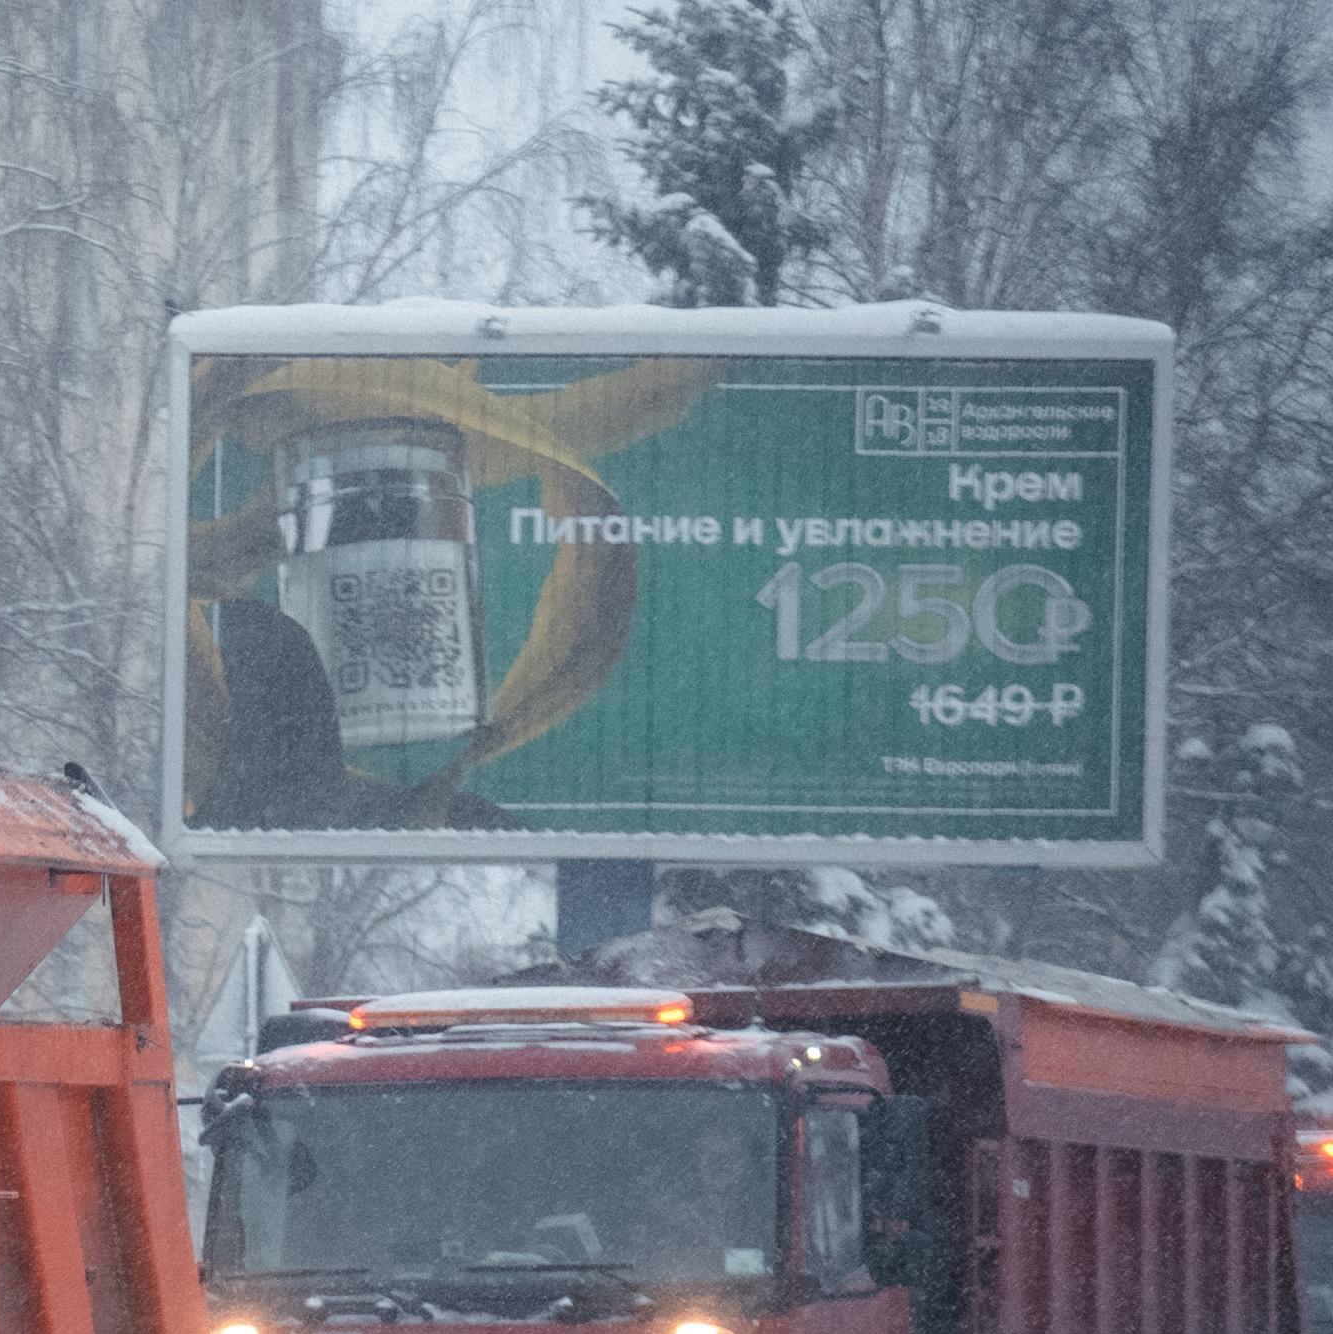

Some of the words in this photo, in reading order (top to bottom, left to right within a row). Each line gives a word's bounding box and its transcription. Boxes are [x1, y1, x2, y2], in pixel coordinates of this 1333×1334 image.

[948, 462, 1082, 511] Крем
[509, 508, 721, 545] Питание
[734, 517, 762, 545] и
[776, 517, 1082, 555] увлажнение
